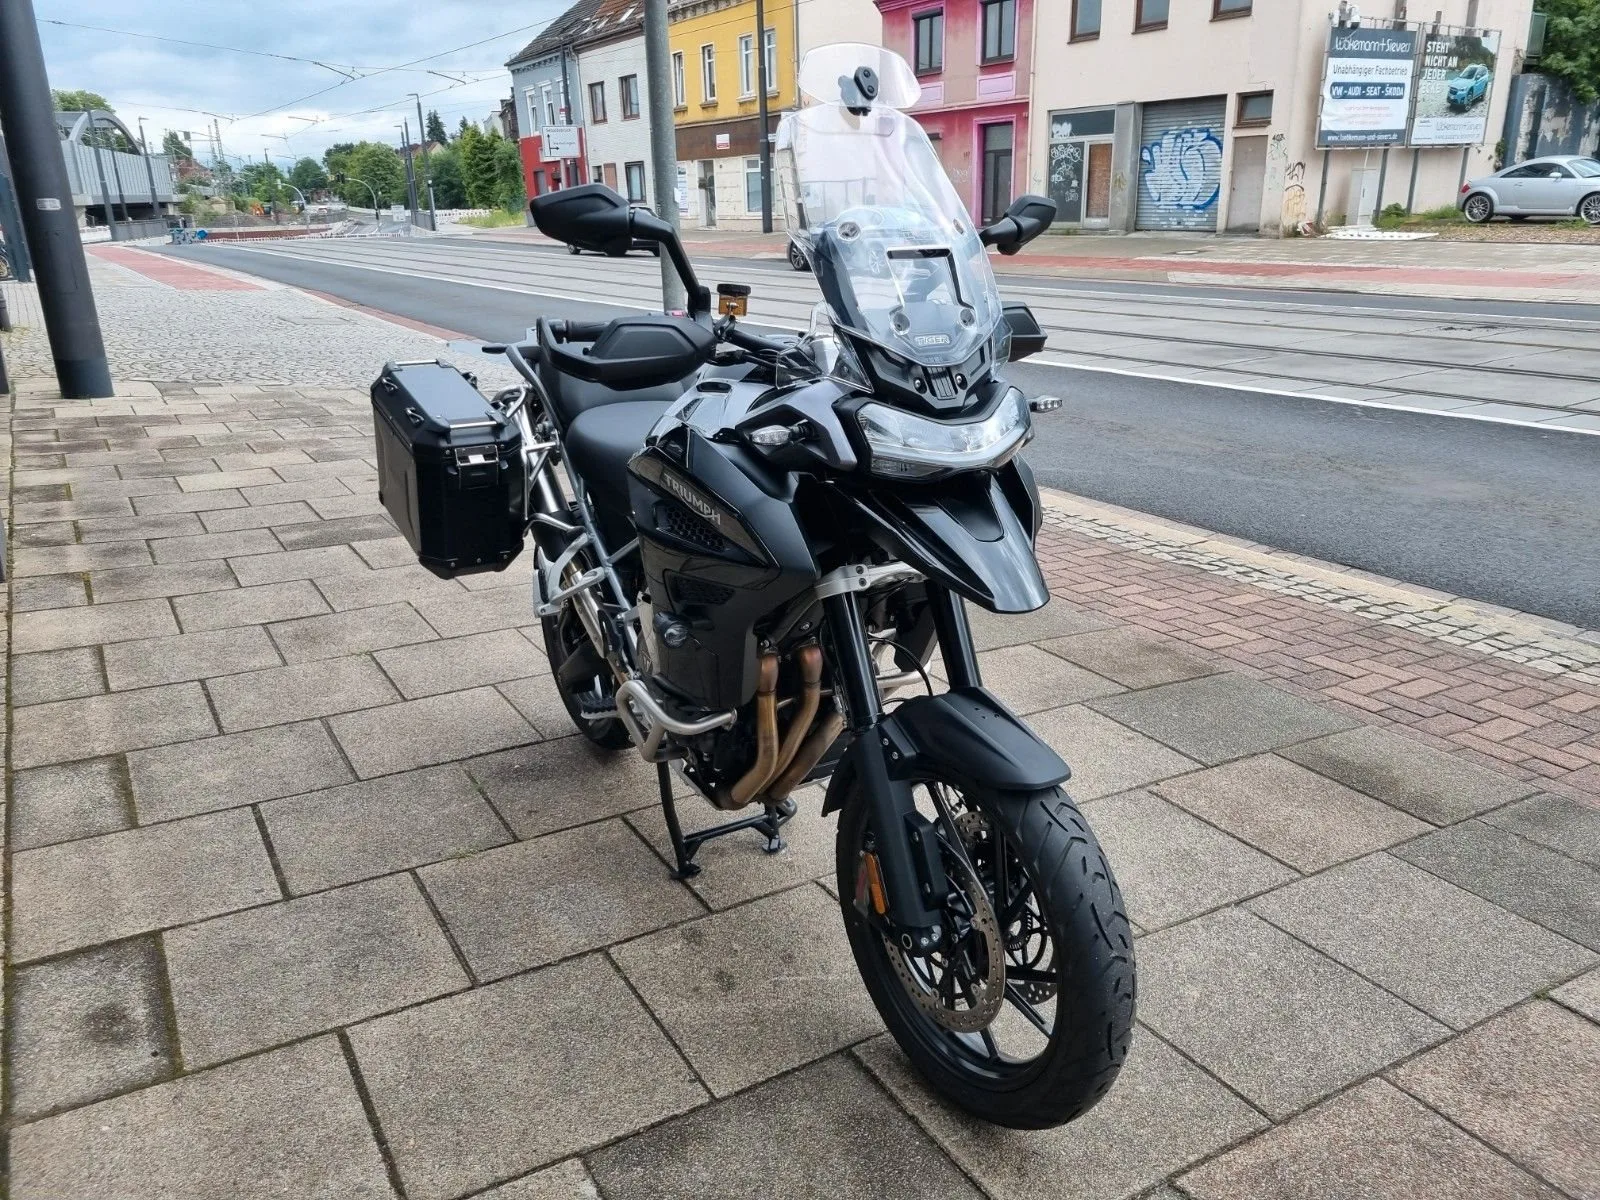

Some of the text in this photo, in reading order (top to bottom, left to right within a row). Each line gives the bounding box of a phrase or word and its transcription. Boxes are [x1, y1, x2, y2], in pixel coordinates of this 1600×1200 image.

[1426, 42, 1450, 53] STEHT
[1424, 55, 1458, 68] NICHT AN
[1333, 64, 1374, 76] Unabhängiger
[1423, 69, 1446, 80] JEDER
[1332, 85, 1343, 97] VW
[1347, 86, 1362, 96] AUDI
[1366, 86, 1381, 96] SEAT
[1384, 83, 1404, 97] ŠKODA
[916, 336, 950, 345] TIGER
[663, 472, 721, 526] TRIUMPH
